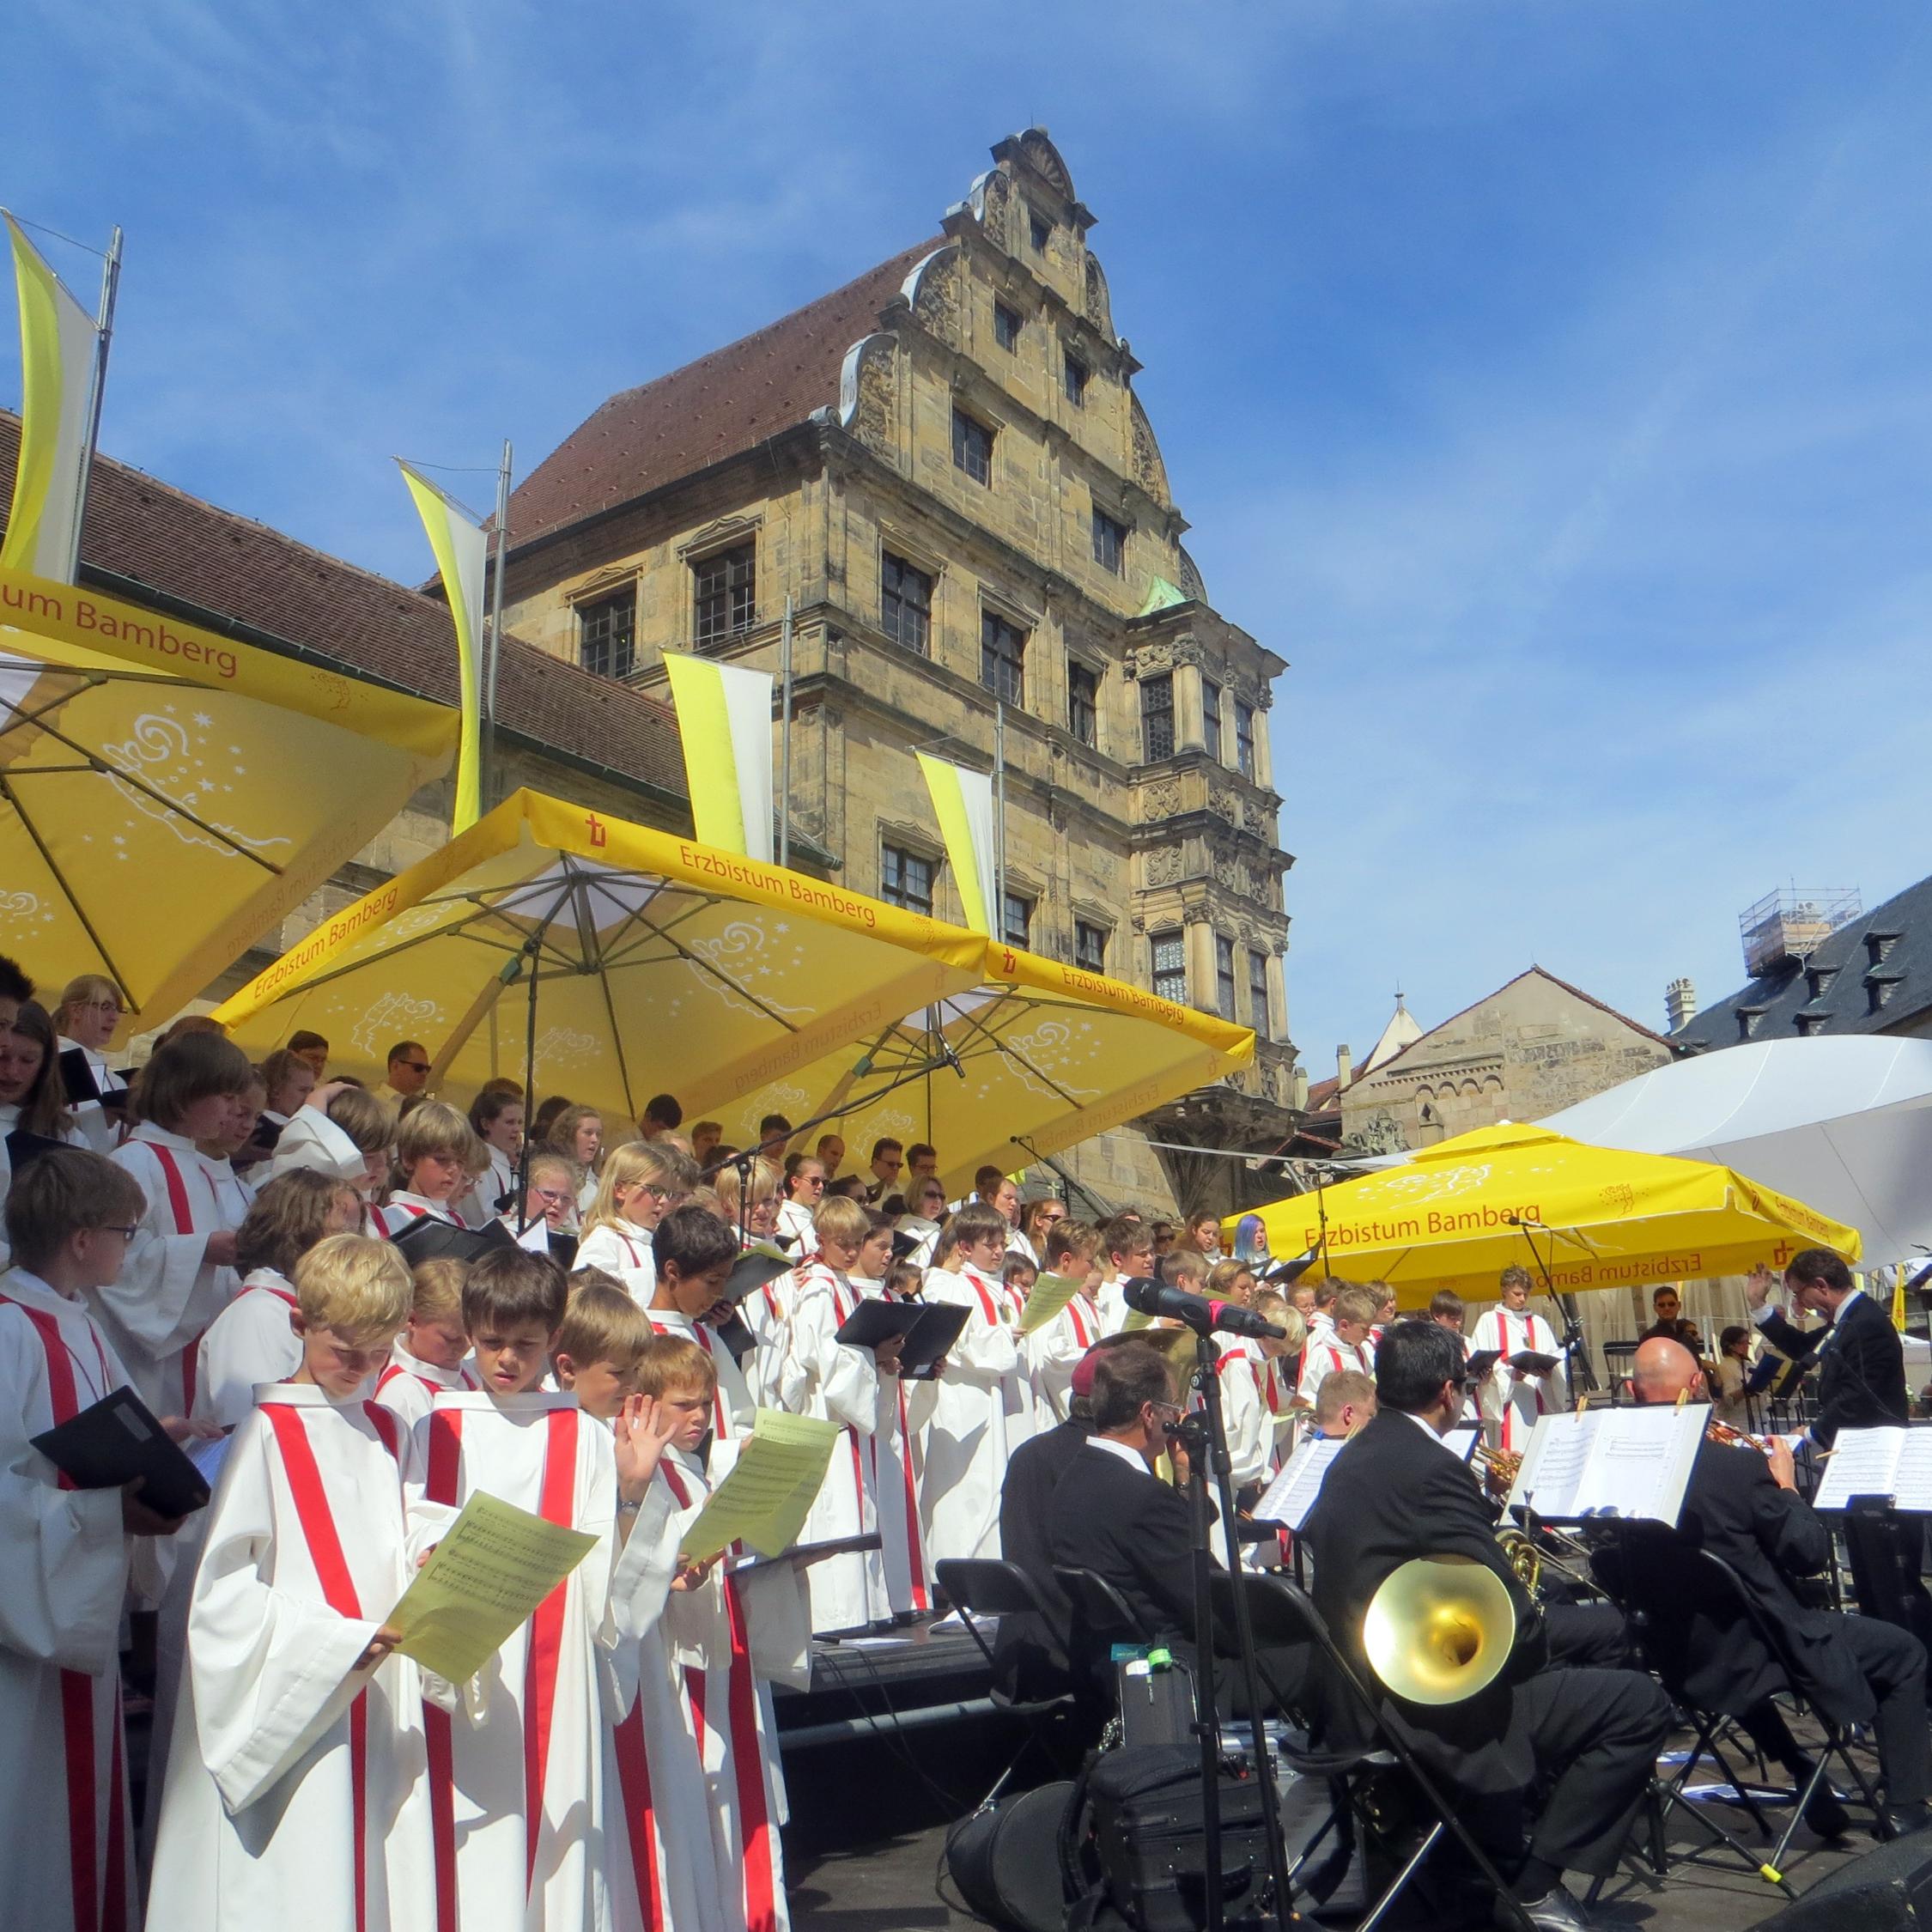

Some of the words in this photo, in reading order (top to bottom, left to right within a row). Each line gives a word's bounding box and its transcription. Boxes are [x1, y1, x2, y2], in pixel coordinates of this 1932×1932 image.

[76, 600, 238, 678] Bamberg
[679, 845, 785, 895] Erzbistum
[788, 878, 876, 928] Bamberg
[254, 938, 325, 999] Erzbistum
[329, 886, 398, 946] Bamberg
[1060, 967, 1129, 1003] Erzbistum
[1133, 988, 1184, 1025] Bamberg
